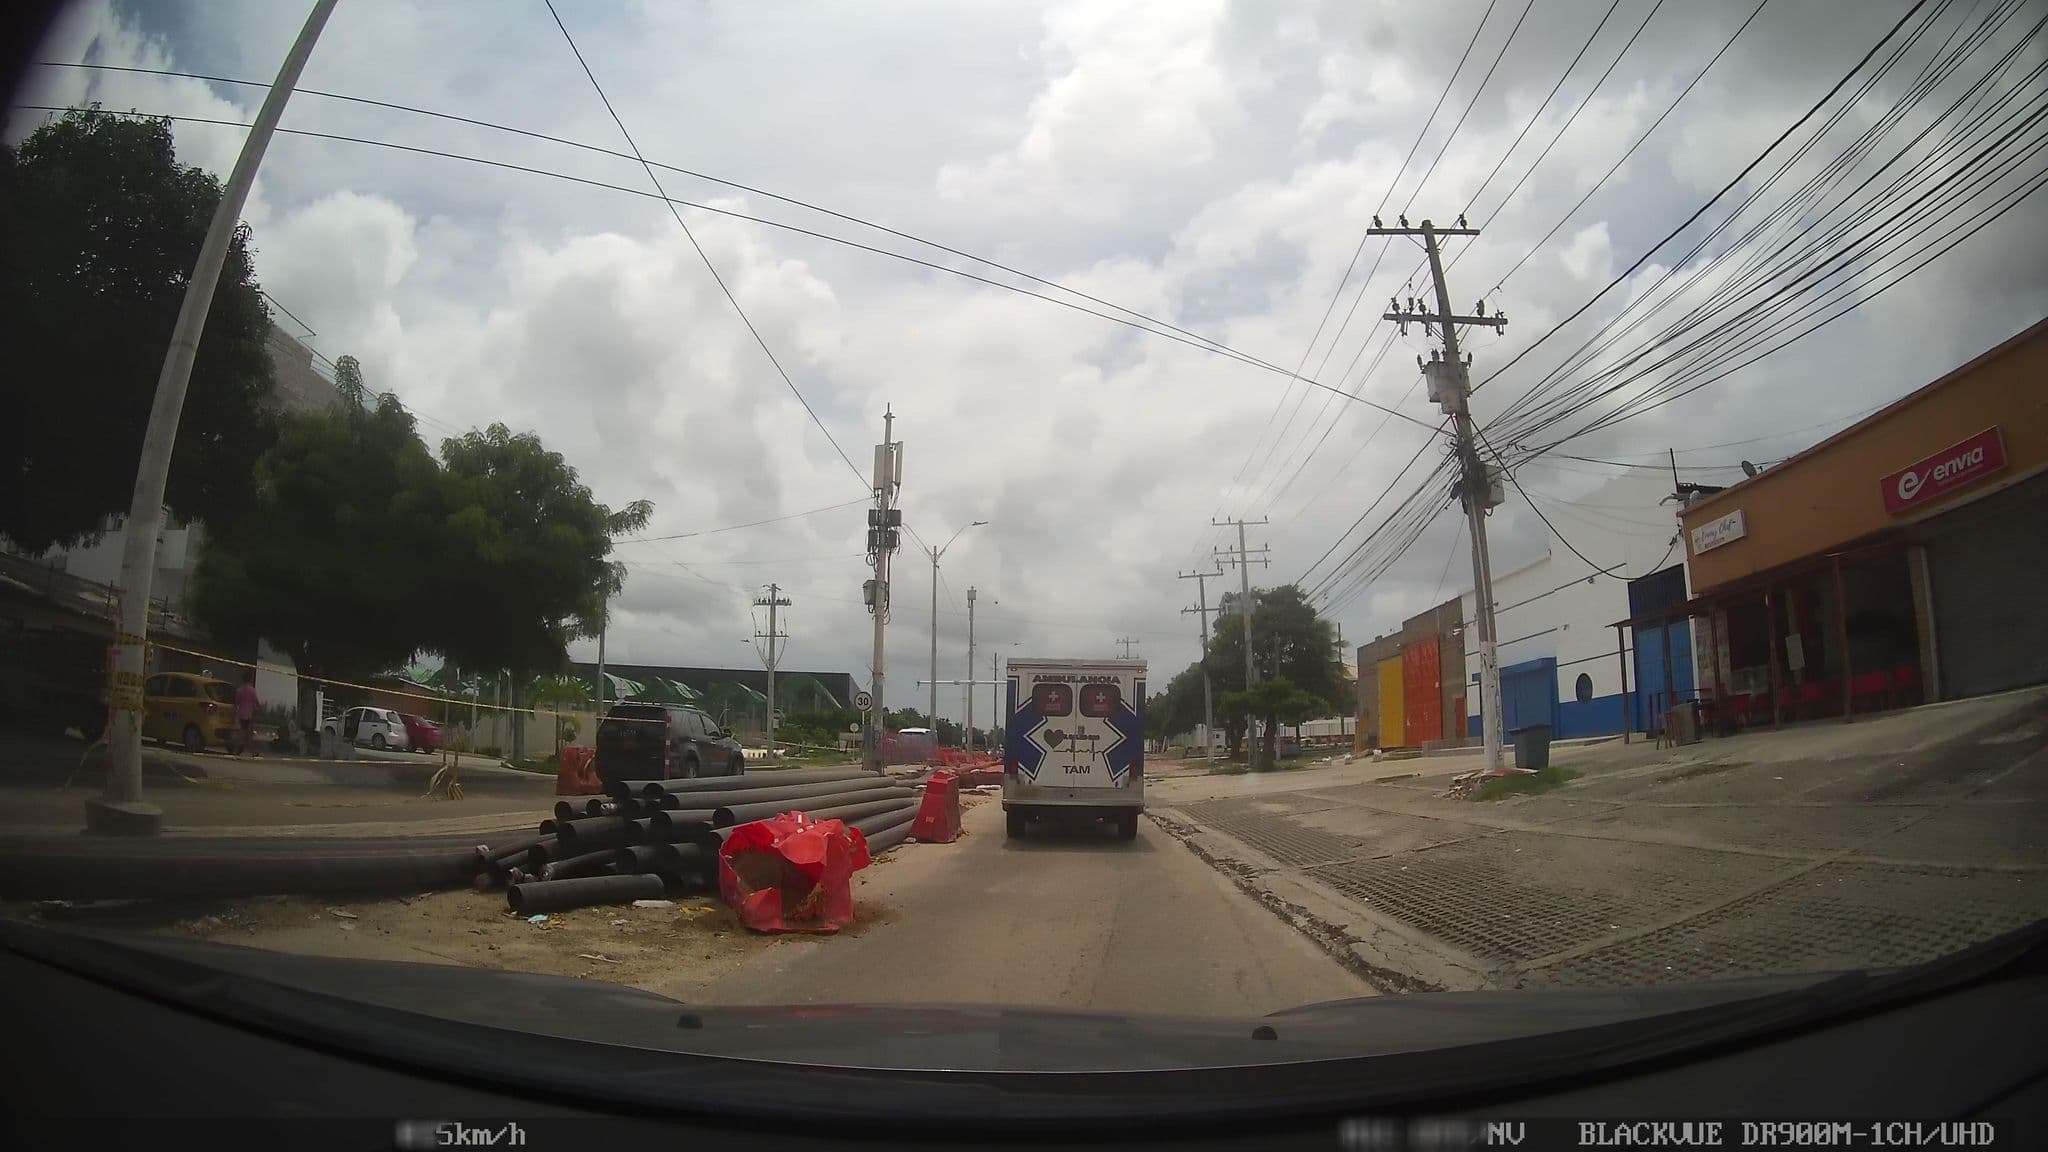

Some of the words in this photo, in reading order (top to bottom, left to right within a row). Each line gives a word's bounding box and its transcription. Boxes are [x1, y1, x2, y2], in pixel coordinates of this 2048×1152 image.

[1032, 675, 1121, 684] AMBULANCIA
[858, 697, 869, 706] 30
[1062, 765, 1090, 774] TAM
